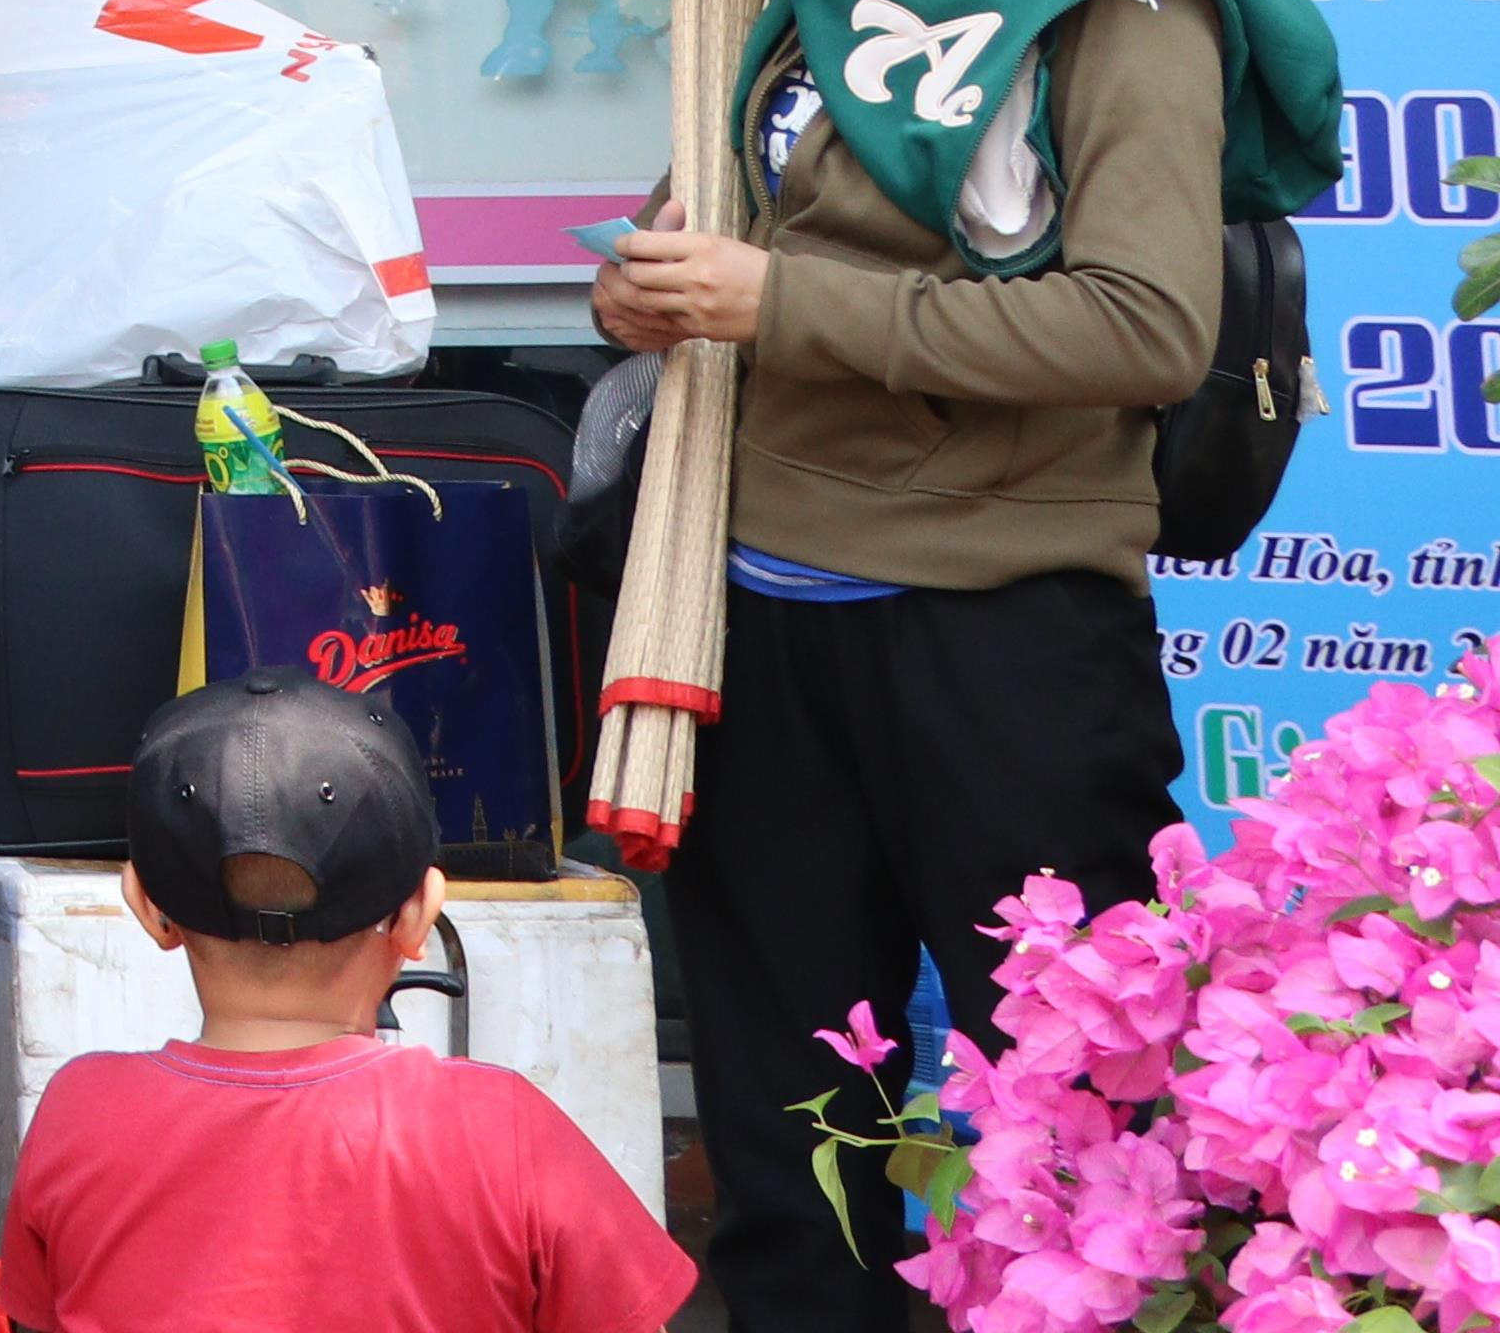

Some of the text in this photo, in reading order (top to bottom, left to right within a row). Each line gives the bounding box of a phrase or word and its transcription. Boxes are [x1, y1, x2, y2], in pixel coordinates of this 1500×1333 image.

[1253, 536, 1390, 593] Hòa,
[308, 614, 461, 688] Danisa
[1222, 621, 1285, 668] 02
[1307, 625, 1428, 674] năm
